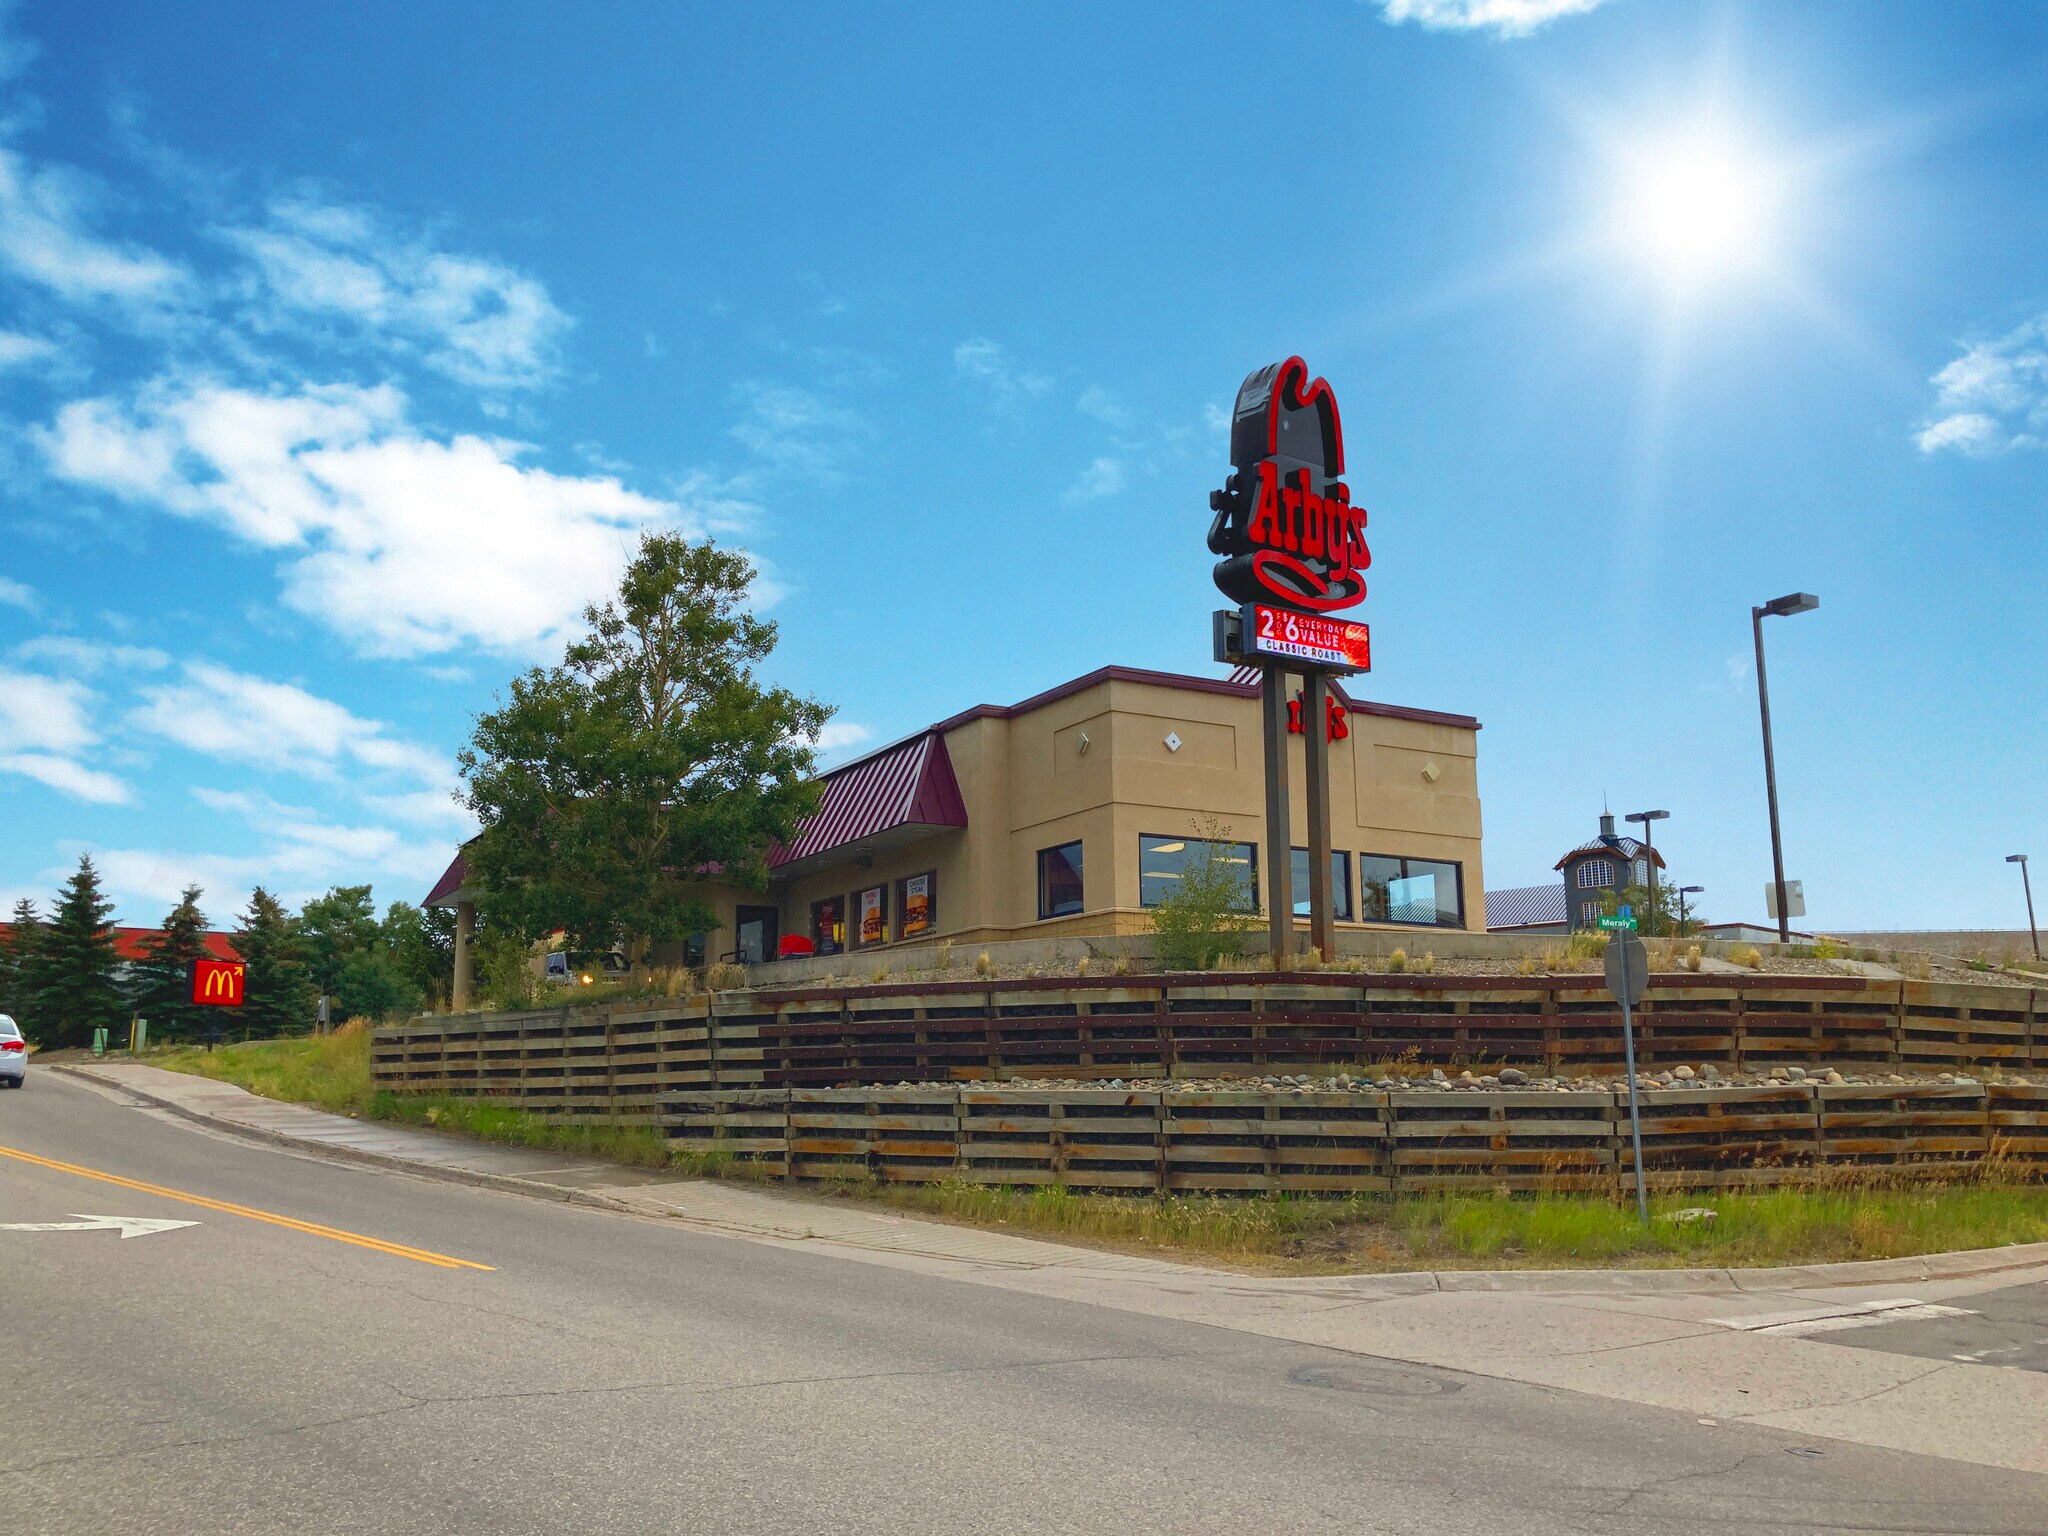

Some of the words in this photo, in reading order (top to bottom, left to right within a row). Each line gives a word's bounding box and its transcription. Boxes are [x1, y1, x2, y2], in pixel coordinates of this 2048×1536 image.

[1248, 461, 1371, 581] Arby's
[1260, 609, 1274, 637] 2
[1299, 618, 1345, 633] EVERYDAY
[1299, 628, 1339, 648] VALUE
[1266, 640, 1306, 655] CLASSIC
[1311, 649, 1341, 660] ROAST
[910, 886, 924, 895] STEAK
[1602, 919, 1630, 928] Meraly
